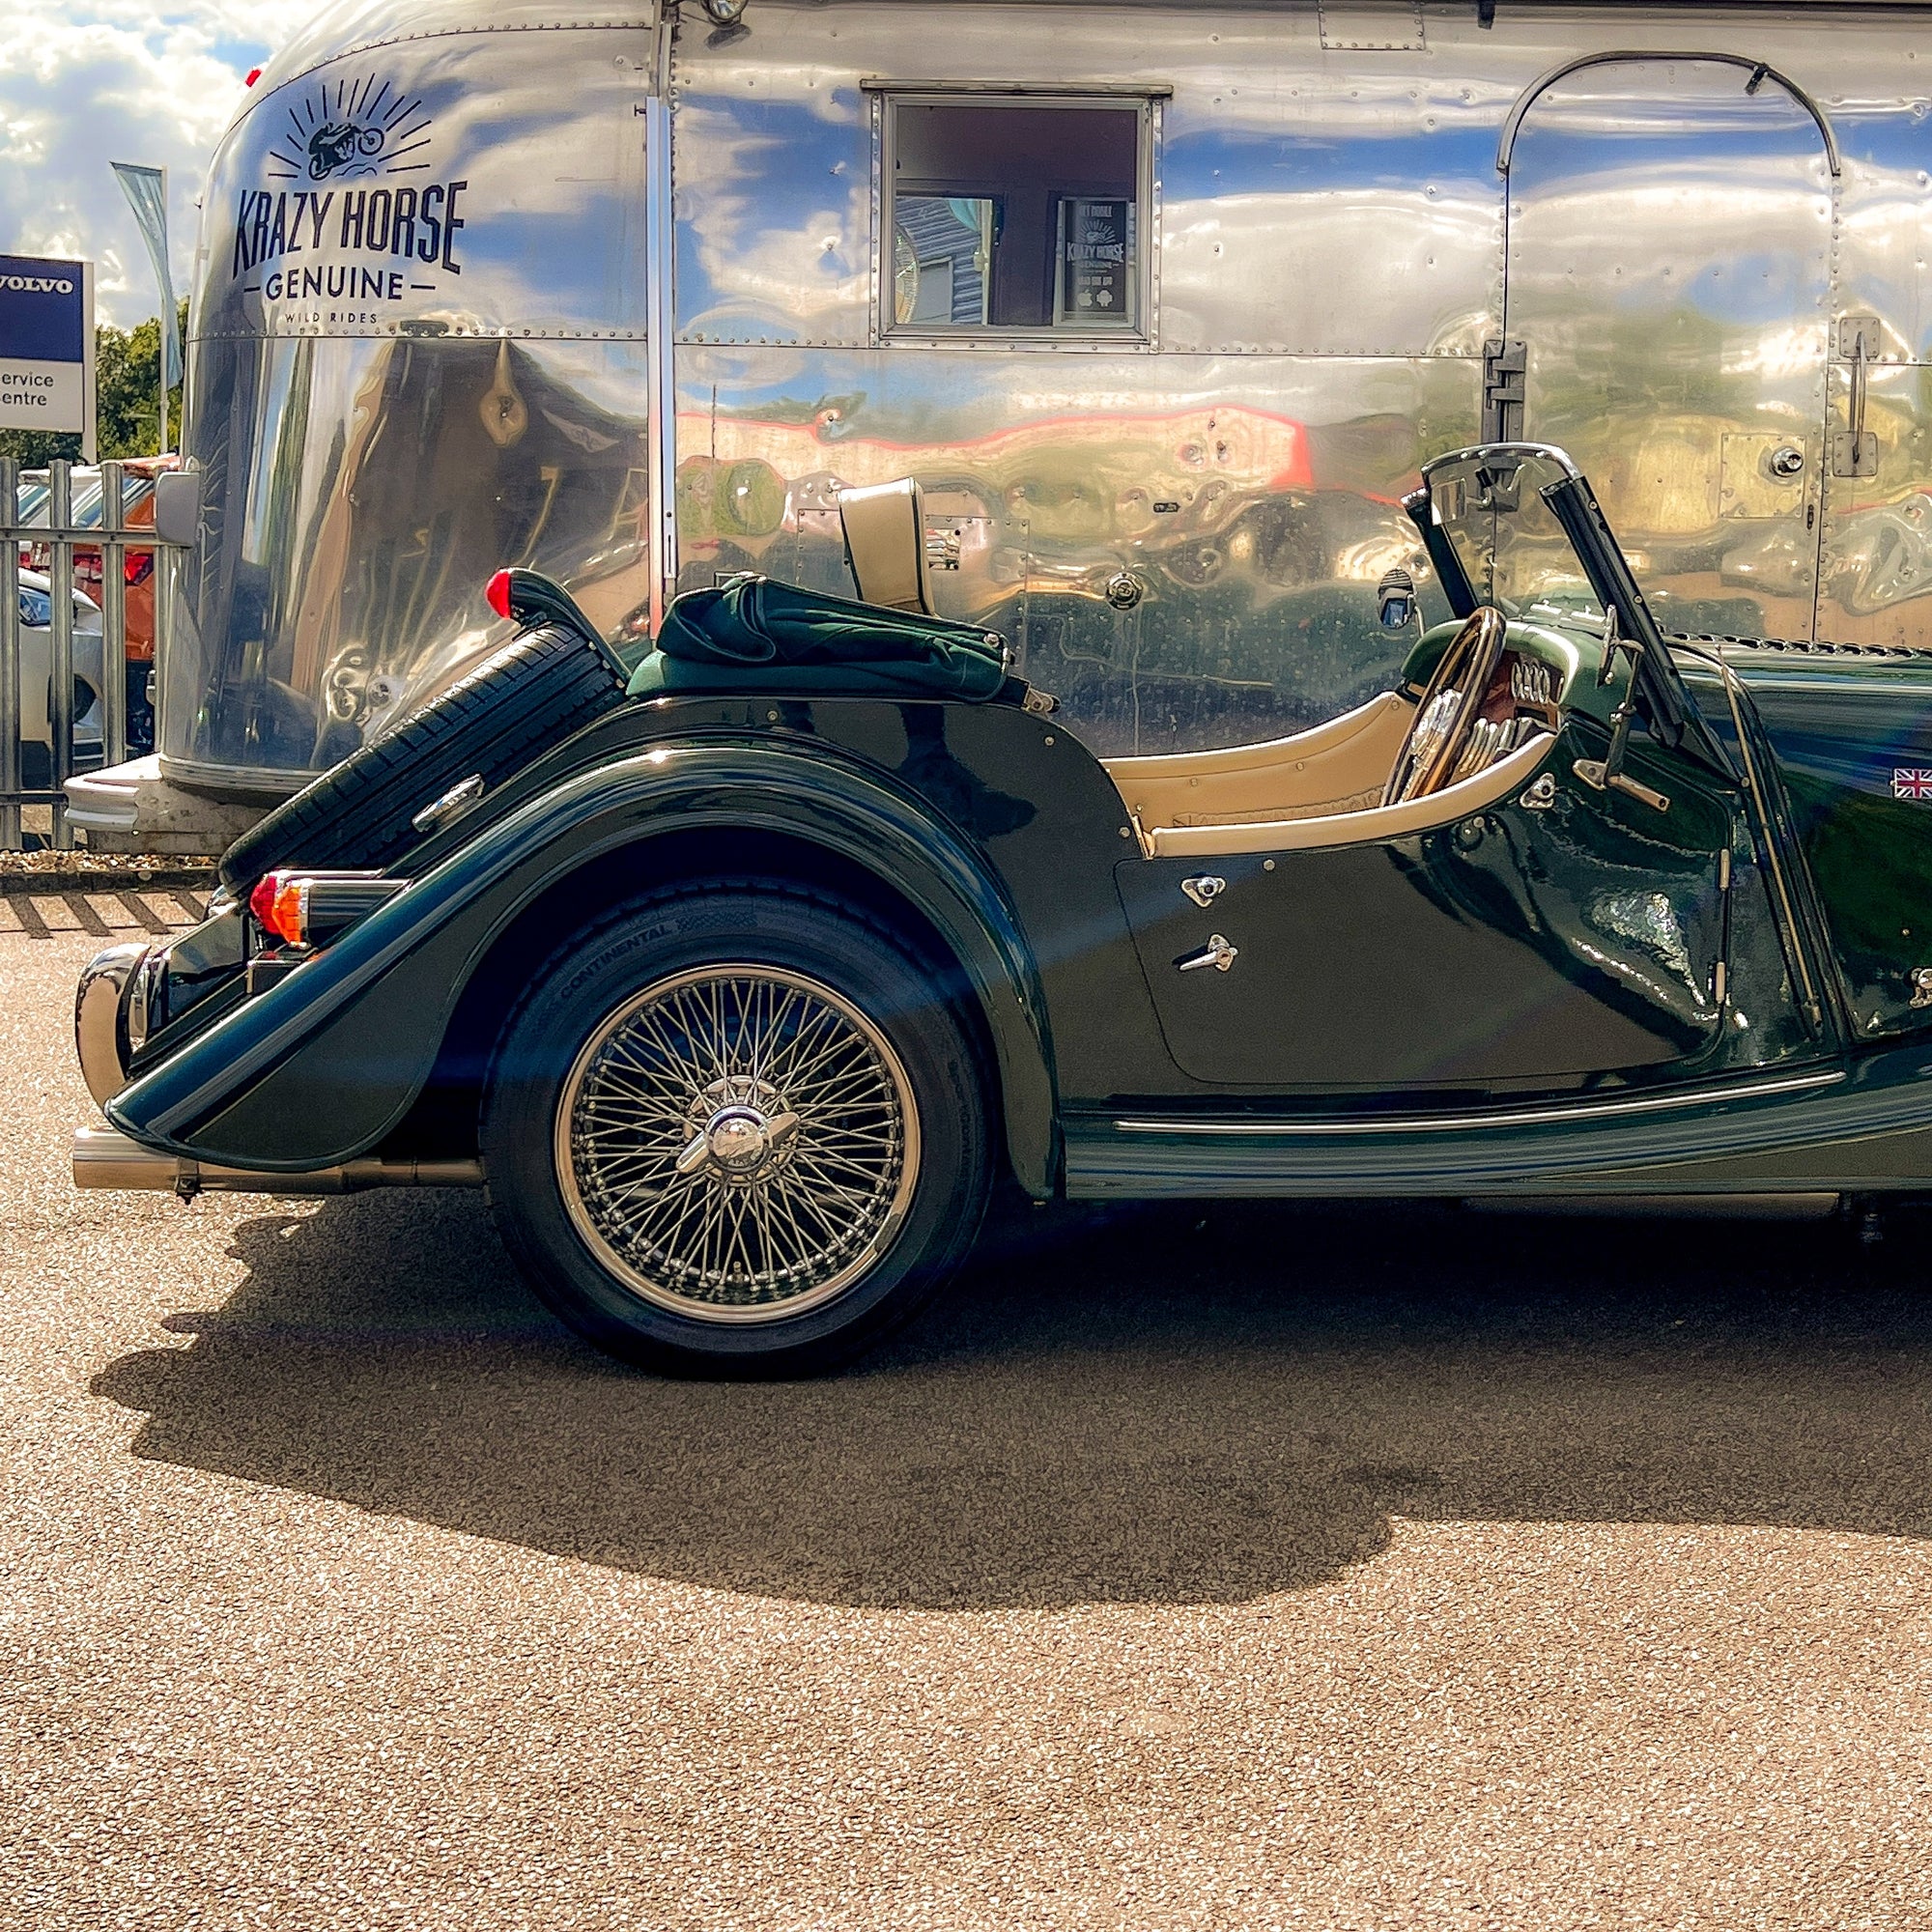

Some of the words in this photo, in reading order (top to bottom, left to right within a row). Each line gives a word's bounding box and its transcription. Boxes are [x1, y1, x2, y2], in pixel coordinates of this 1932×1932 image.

[232, 188, 334, 280] KRAZY
[339, 180, 469, 275] HORSE
[266, 265, 404, 300] GENUINE
[285, 312, 321, 324] WILD
[329, 312, 377, 324] RIDES
[0, 371, 54, 387] ervice
[0, 391, 47, 406] entre
[560, 923, 673, 999] CONTINENTAL
